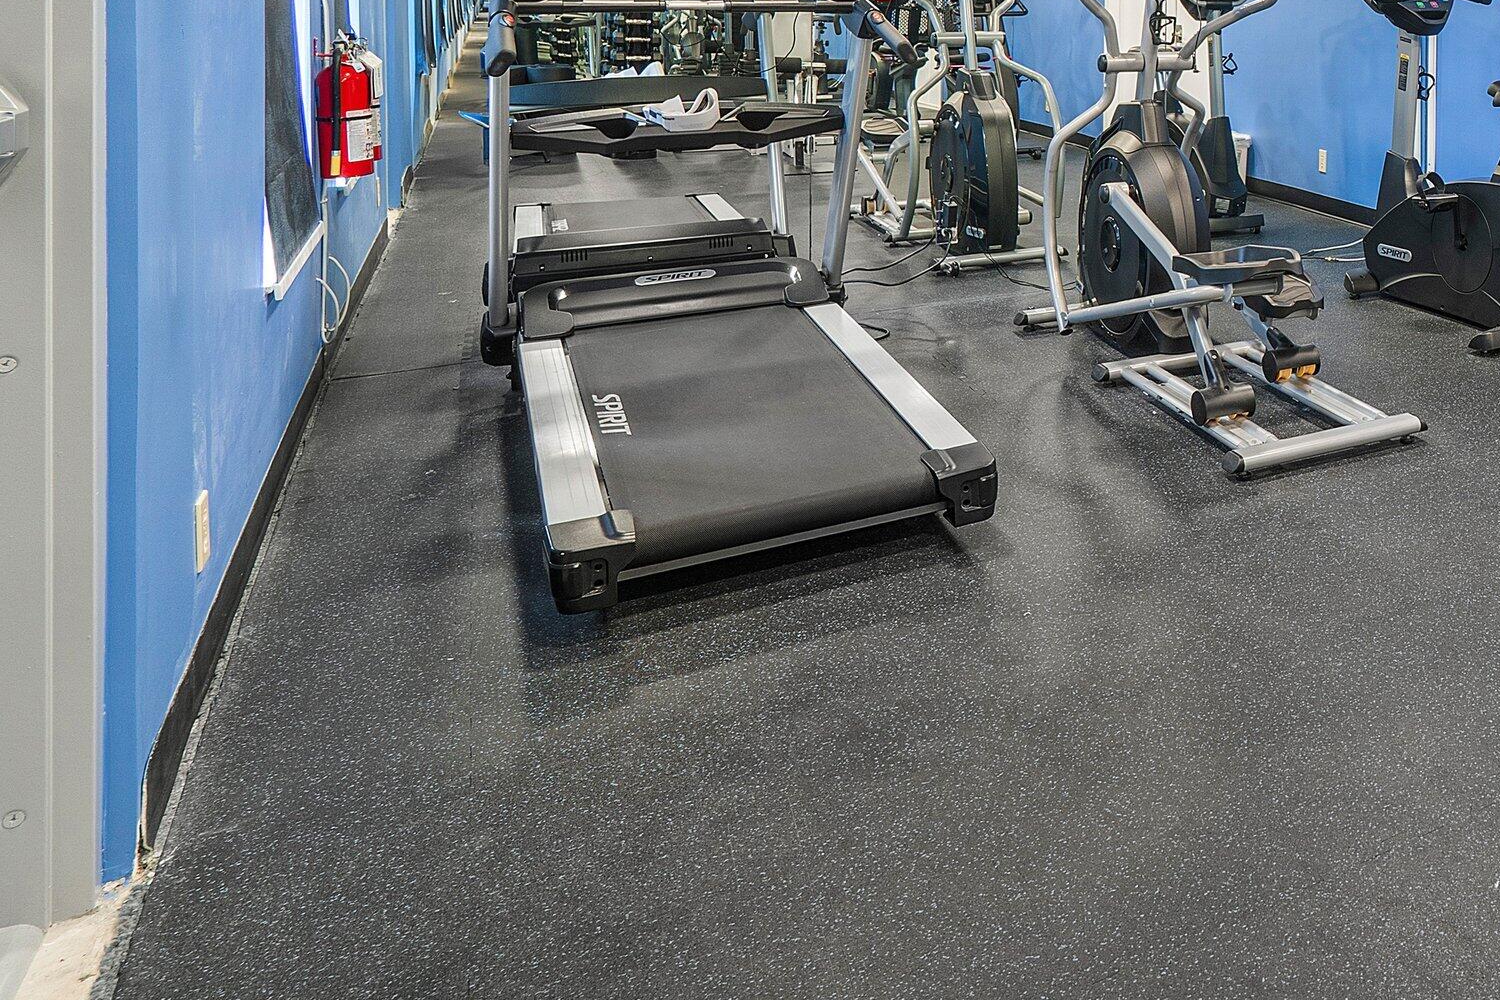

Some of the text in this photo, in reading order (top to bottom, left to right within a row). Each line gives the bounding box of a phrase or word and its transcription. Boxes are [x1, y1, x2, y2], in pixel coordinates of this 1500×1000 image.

[1381, 247, 1408, 259] SPIRIT
[643, 271, 708, 283] SPIRIT
[591, 393, 632, 436] SPIRIT
